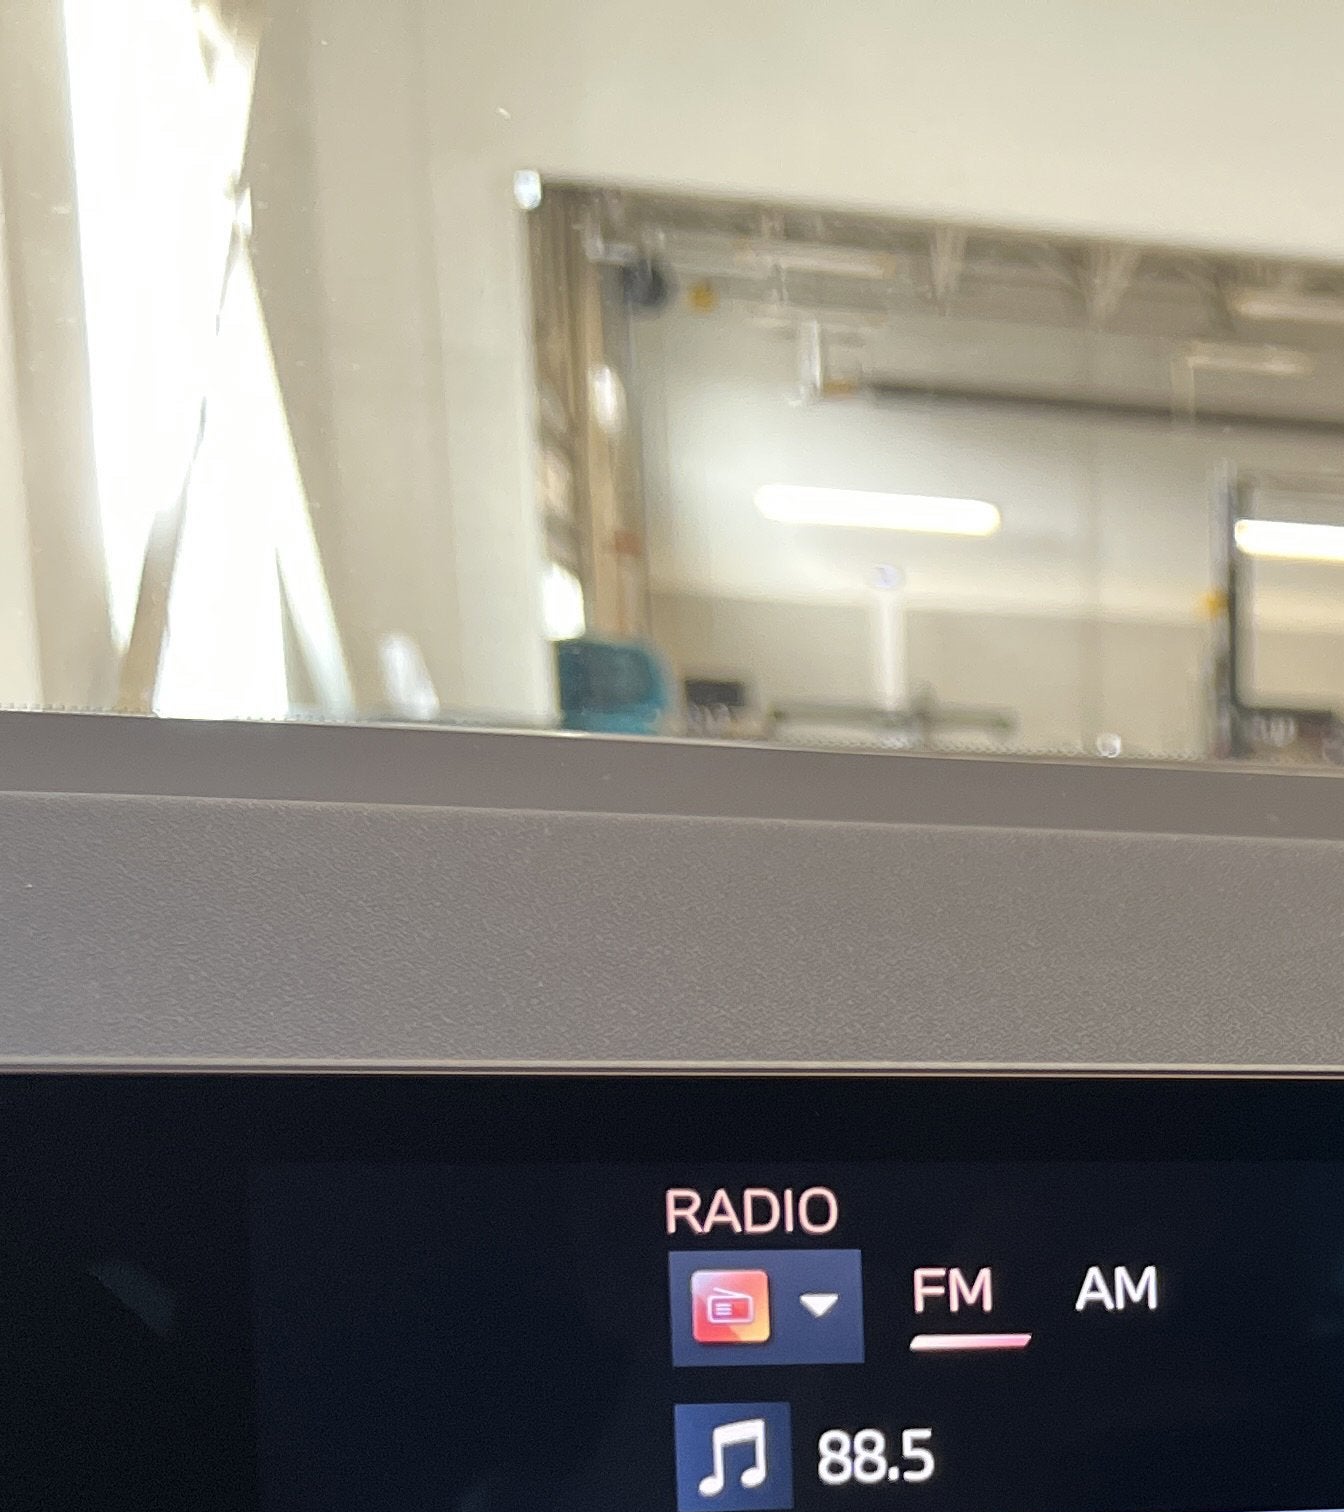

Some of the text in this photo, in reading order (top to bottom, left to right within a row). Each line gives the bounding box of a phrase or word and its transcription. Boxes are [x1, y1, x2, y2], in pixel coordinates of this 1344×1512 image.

[665, 1186, 839, 1235] RADIO
[912, 1267, 993, 1313] FM
[1075, 1265, 1158, 1312] AM
[817, 1428, 936, 1486] 88.5
